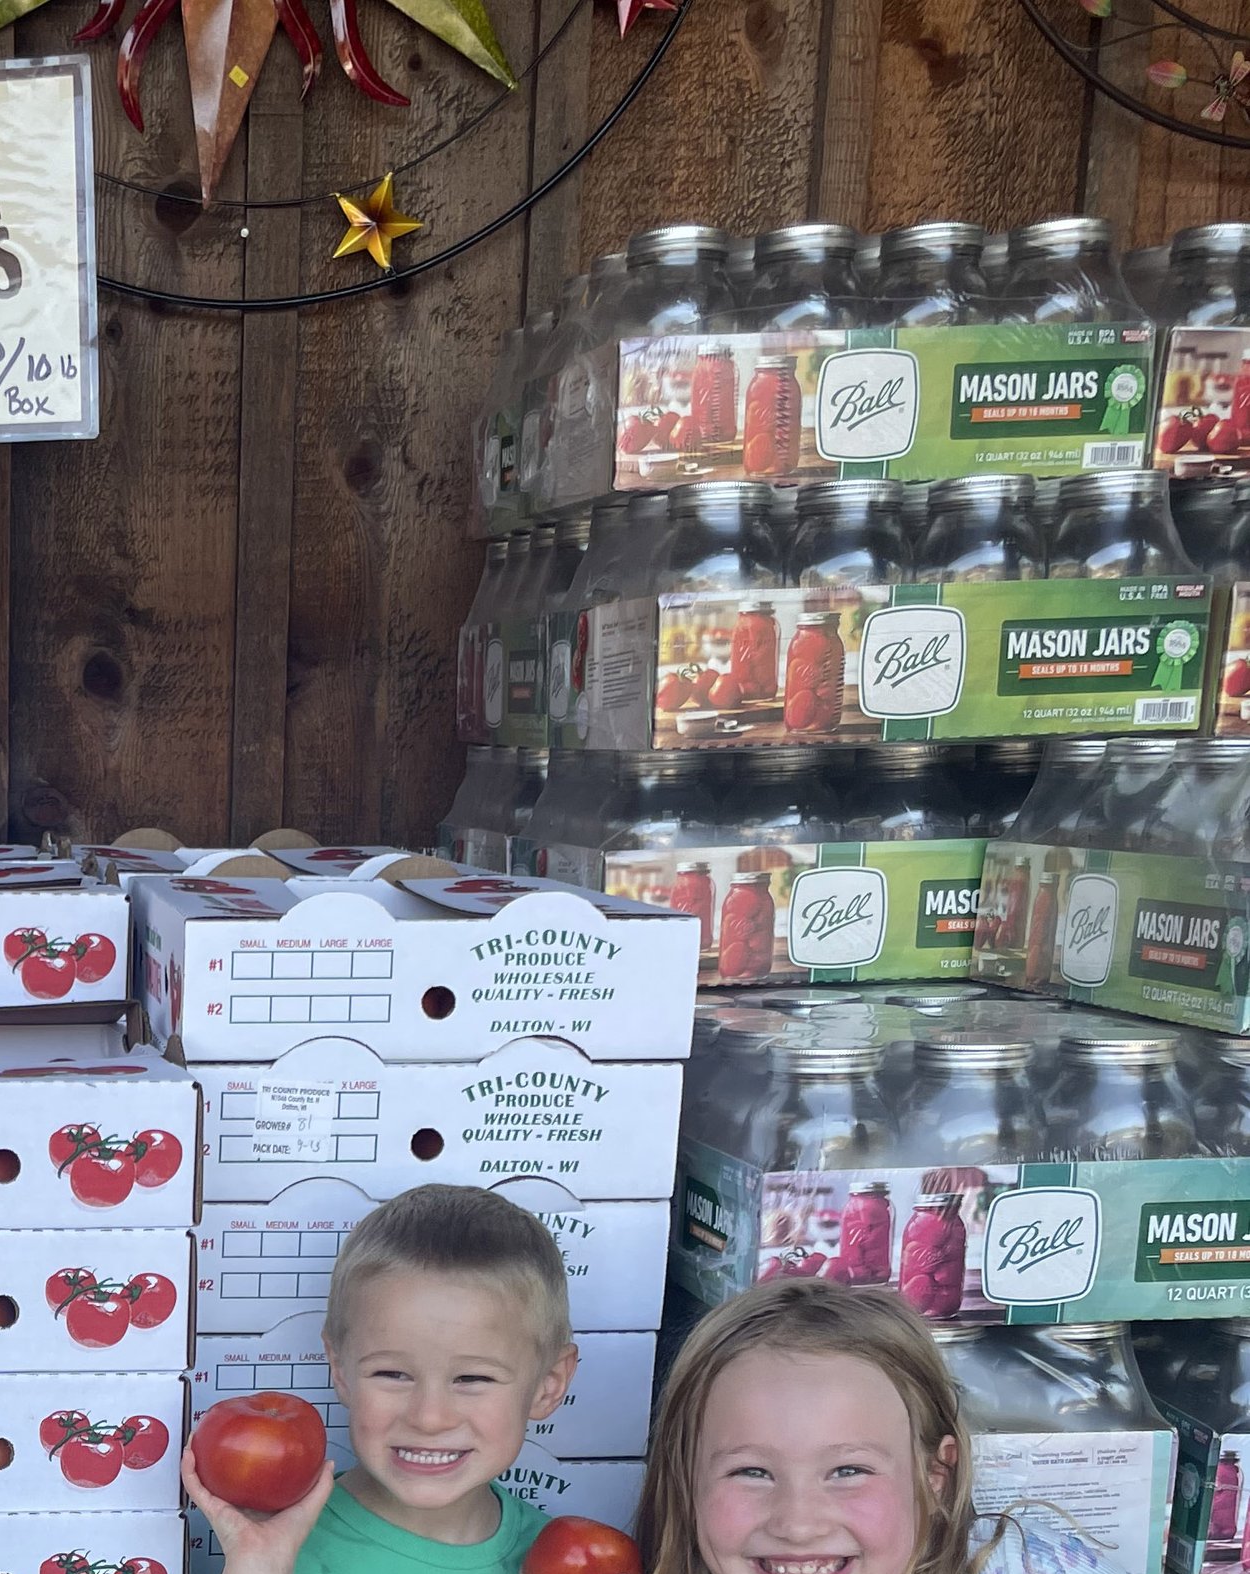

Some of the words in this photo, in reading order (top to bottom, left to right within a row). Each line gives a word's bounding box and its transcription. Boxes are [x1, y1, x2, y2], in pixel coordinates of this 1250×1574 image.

[959, 372, 1038, 403] MASON
[1041, 370, 1098, 400] JARS
[4, 386, 54, 416] Box
[830, 376, 905, 431] Ball
[1007, 629, 1088, 660] MASON
[1092, 627, 1150, 657] JARS
[873, 633, 951, 689] Ball
[1031, 664, 1055, 675] SEALS
[1056, 664, 1066, 674] UP
[1068, 664, 1077, 674] TO
[1089, 662, 1119, 673] MONTHS
[1023, 709, 1033, 719] 12
[1034, 708, 1064, 719] QUART
[1080, 708, 1092, 717] oz
[925, 889, 981, 915] MASO
[800, 892, 874, 941] Ball
[1069, 905, 1110, 954] Ball
[1136, 911, 1183, 944] MASON
[1184, 917, 1220, 950] JARS
[239, 939, 267, 948] SMALL
[276, 939, 311, 948] MEDIUM
[319, 939, 348, 948] LARGE
[364, 938, 393, 948] LARGE
[470, 929, 622, 961] TRI-COUNTY
[209, 959, 223, 971] #1
[504, 952, 586, 966] PRODUCE
[493, 972, 596, 985] WHOLESALE
[471, 988, 544, 1003] QUALITY
[558, 988, 615, 1001] FRESH
[207, 1003, 223, 1016] #2
[490, 1020, 555, 1033] DALTON
[571, 1020, 592, 1032] WI
[227, 1082, 254, 1091] SMALL
[349, 1081, 378, 1090] LARGE
[461, 1071, 610, 1103] TRI-COUNTY
[494, 1094, 575, 1107] PRODUCE
[255, 1120, 291, 1131] GROWER#
[484, 1113, 583, 1125] WHOLESALE
[461, 1128, 533, 1144] QUALITY
[547, 1128, 603, 1142] FRESH
[252, 1143, 271, 1153] PACK
[479, 1160, 543, 1173] DALTON
[559, 1160, 580, 1173] WI
[230, 1221, 257, 1229] SMALL
[266, 1221, 299, 1229] MEDIUM
[307, 1221, 334, 1229] LARGE
[1147, 1212, 1237, 1244] MASON
[201, 1239, 214, 1250] #1
[997, 1216, 1084, 1274] Ball
[1174, 1251, 1200, 1261] SEALS
[1202, 1251, 1213, 1260] UP
[1215, 1251, 1225, 1260] TO
[1227, 1250, 1238, 1260] 18
[1167, 1288, 1182, 1300] 12
[1186, 1286, 1235, 1300] QUART
[299, 1353, 326, 1361] LARGE
